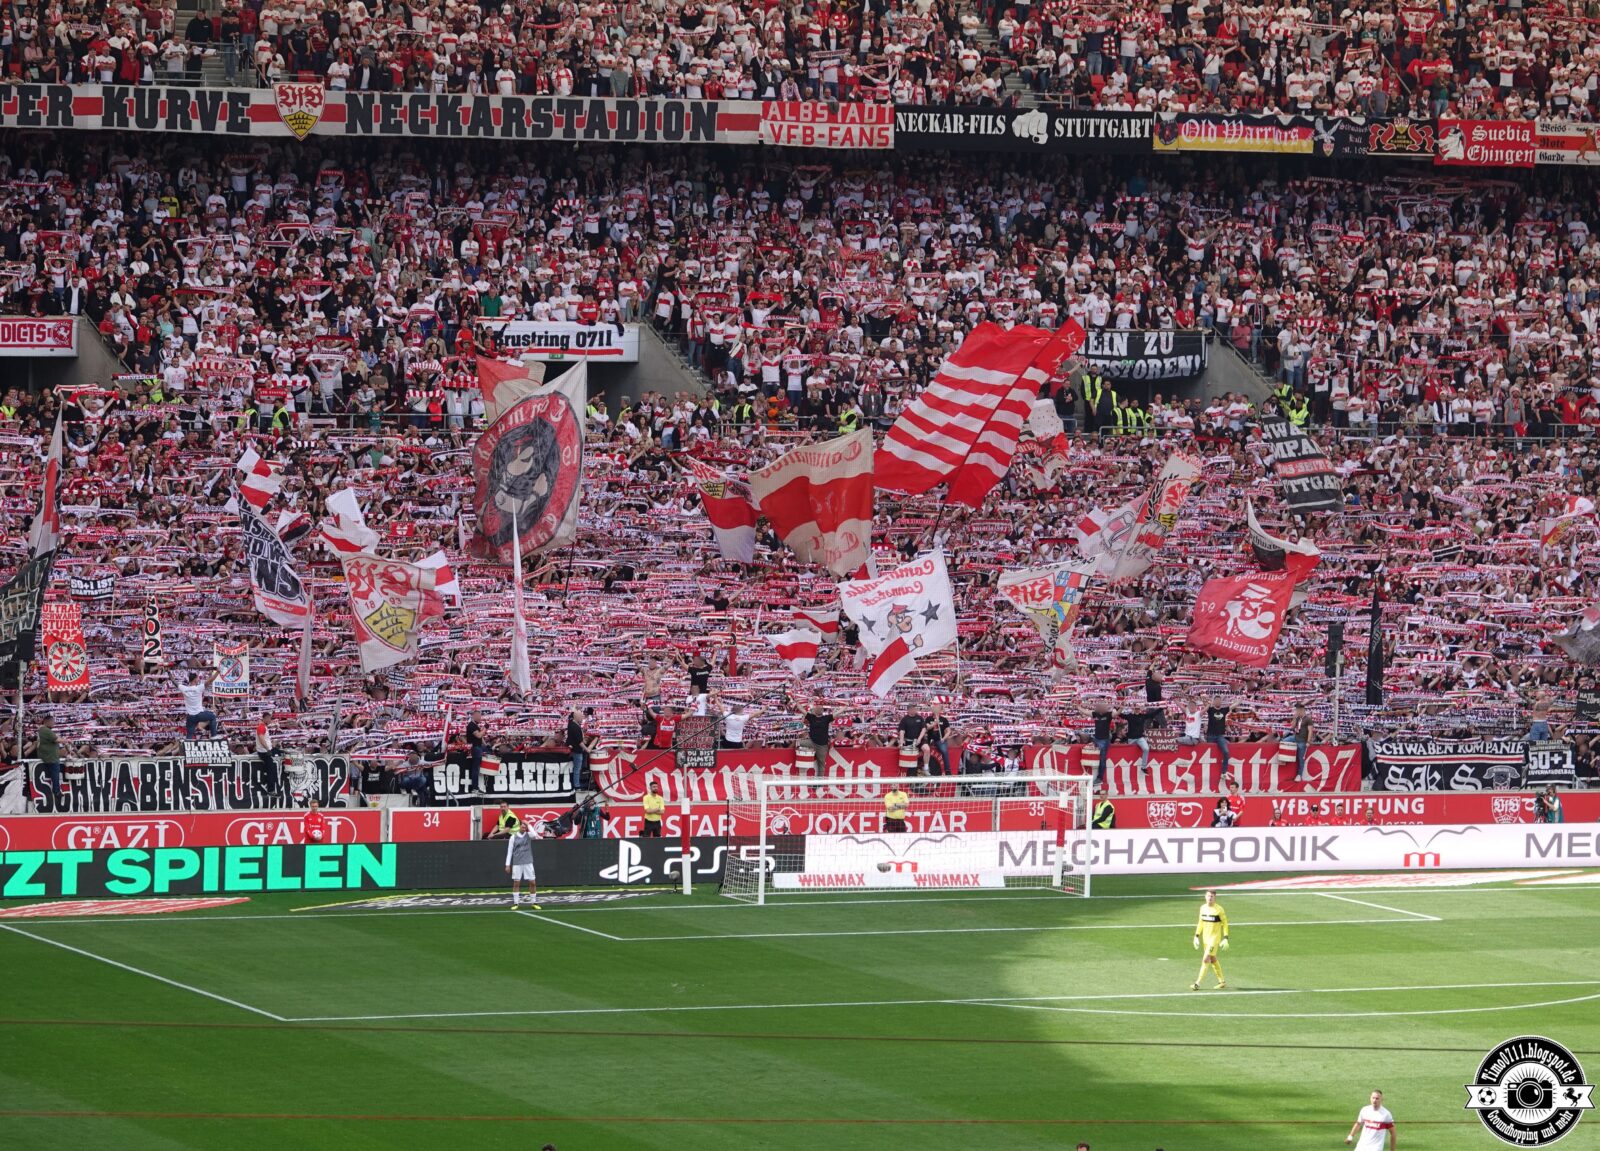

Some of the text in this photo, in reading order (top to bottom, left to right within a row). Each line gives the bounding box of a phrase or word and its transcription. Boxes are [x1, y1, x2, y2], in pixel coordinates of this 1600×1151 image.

[102, 86, 251, 134] KURVE
[346, 93, 719, 142] NECKARSTADION
[766, 100, 894, 124] ALBSTADT
[895, 111, 1153, 139] NECKAR-FILS STUTTGART
[1181, 118, 1299, 147] Old Warriors
[1471, 126, 1531, 143] Suebia
[769, 123, 890, 147] VFB-FANS
[1466, 145, 1535, 164] Ehingen
[575, 330, 612, 347] 0711
[1144, 332, 1174, 355] ZU
[42, 603, 80, 613] ULTRAS
[42, 620, 80, 629] STURM
[184, 741, 229, 751] ULTRAS
[185, 750, 230, 758] BEDEUTET
[1374, 741, 1525, 756] SCHWABEN KOMPANIE
[1528, 751, 1576, 770] 50+1
[493, 761, 574, 792] BLEIBT
[1301, 749, 1358, 793] 97
[1028, 801, 1045, 817] 35
[1320, 797, 1425, 816] STIFTUNG
[423, 812, 440, 828] 34
[664, 844, 776, 875] PS5
[998, 832, 1600, 868] MECHATRONIK ME
[0, 844, 397, 897] ZT SPIELEN
[798, 873, 980, 887] WINAMAX WINAMAX
